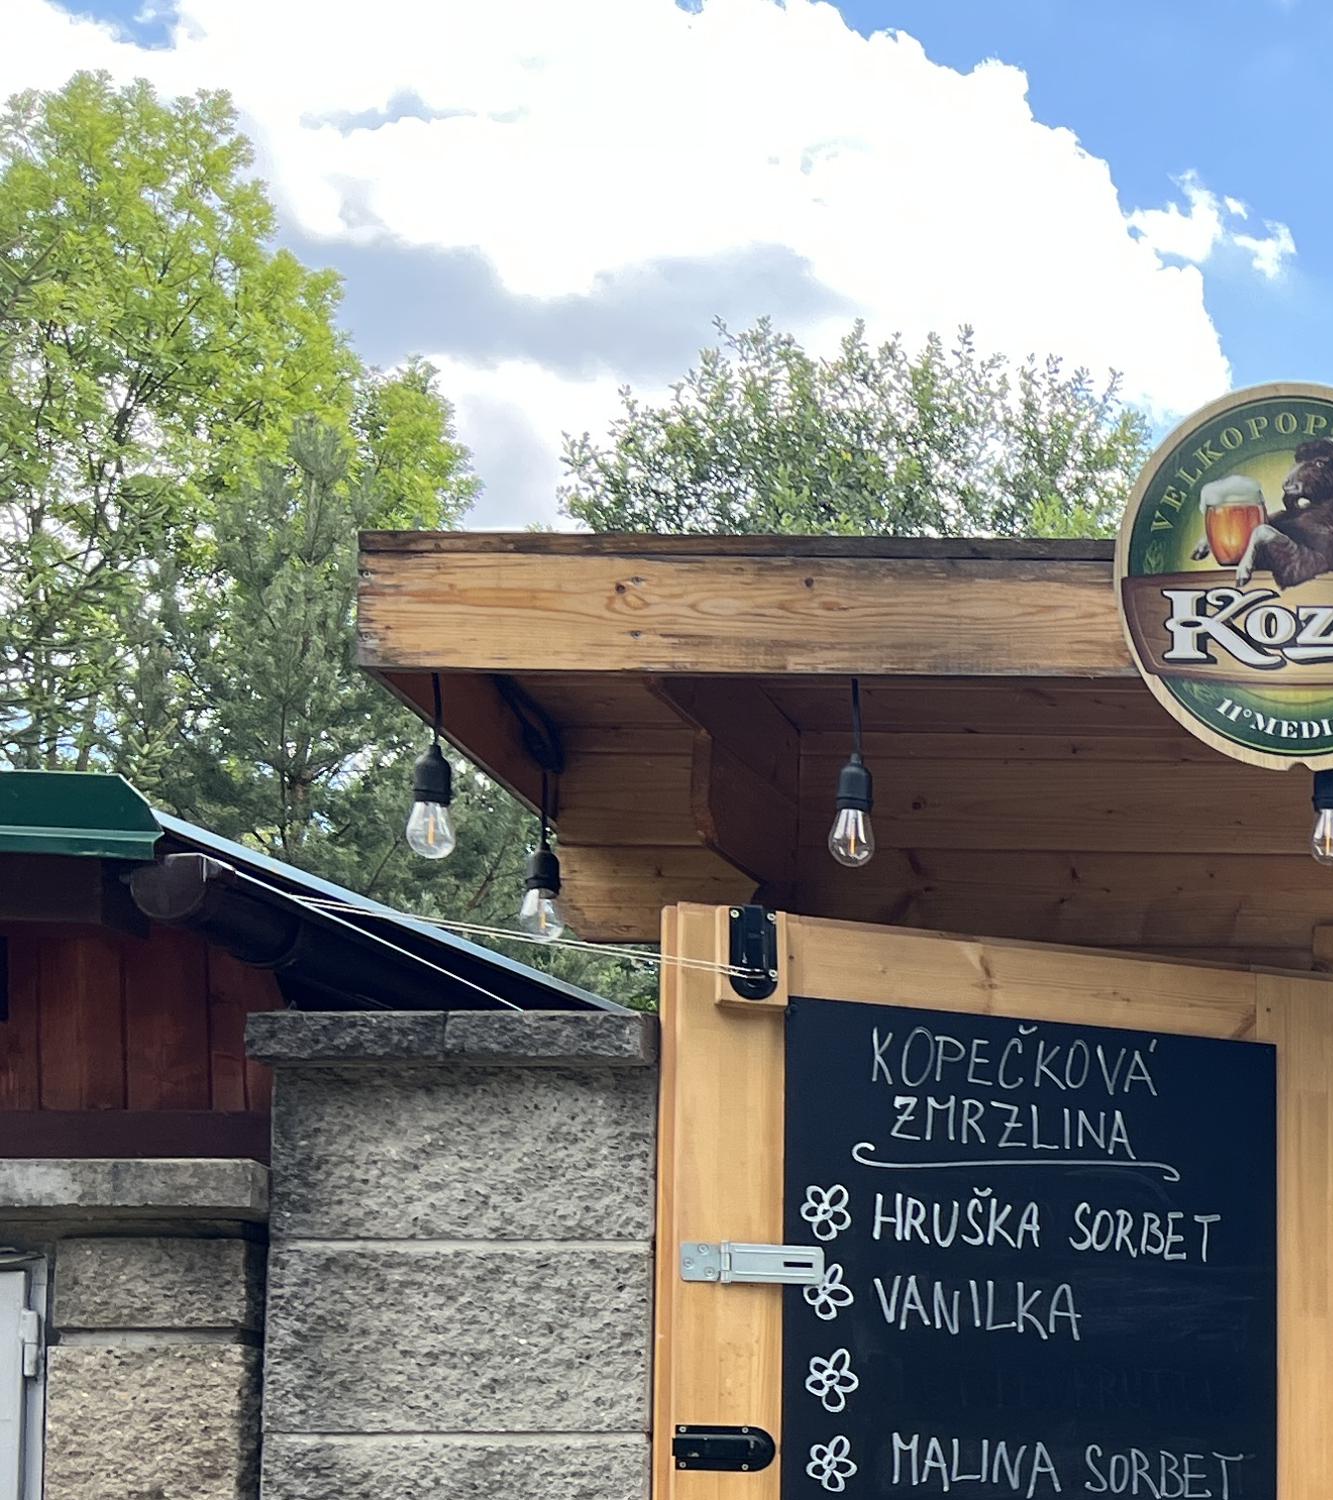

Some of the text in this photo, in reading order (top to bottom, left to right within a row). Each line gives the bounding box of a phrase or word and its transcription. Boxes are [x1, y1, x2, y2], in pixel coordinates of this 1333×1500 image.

[871, 1024, 1158, 1096] KOPEČKOVÁ
[890, 1095, 1136, 1160] ZMRZLINA
[872, 1187, 1222, 1263] HRUŠKA SORBET
[873, 1274, 1082, 1341] VANILKA
[892, 1432, 1244, 1500] MALINA SORBET
